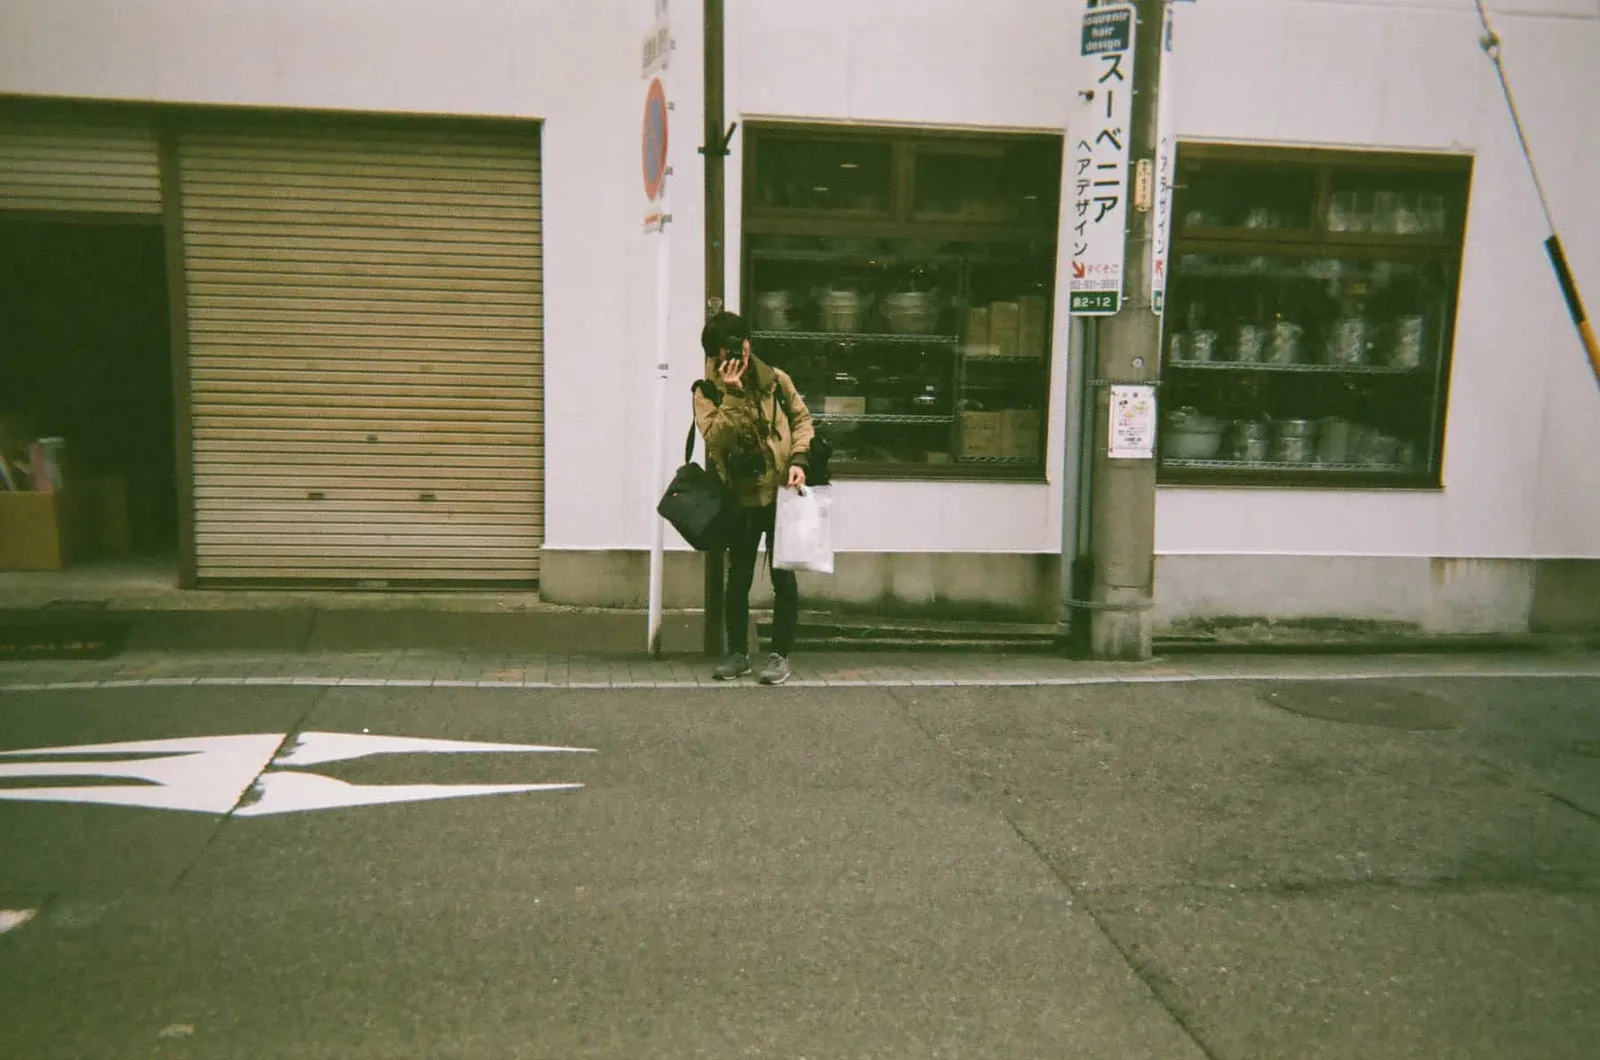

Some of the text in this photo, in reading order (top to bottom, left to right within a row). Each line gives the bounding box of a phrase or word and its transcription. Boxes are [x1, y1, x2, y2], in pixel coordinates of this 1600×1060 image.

[1086, 38, 1121, 52] design
[1092, 26, 1115, 37] hair
[1093, 54, 1124, 223] スーベニア
[1074, 139, 1092, 257] ヘアデザイン
